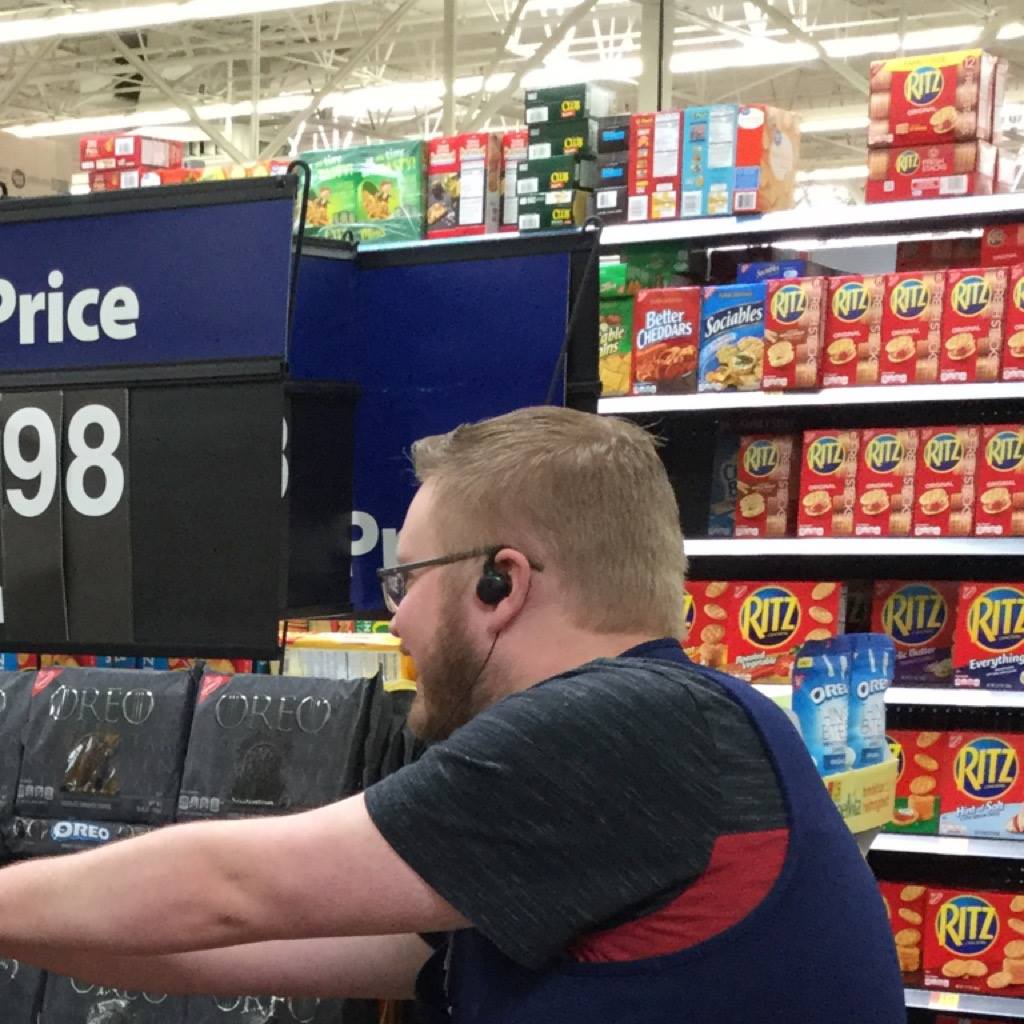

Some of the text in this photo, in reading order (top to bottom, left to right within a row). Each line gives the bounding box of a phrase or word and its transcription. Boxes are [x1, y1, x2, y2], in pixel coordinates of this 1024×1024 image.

[908, 73, 941, 101] RITZ
[772, 290, 805, 319] RITZ
[835, 286, 869, 317] RITZ
[893, 282, 927, 313] RITZ
[953, 282, 991, 310] RITZ
[646, 309, 685, 328] Better
[704, 305, 764, 338] Sociables
[637, 322, 693, 349] CHEDDARS
[745, 445, 776, 472] RITZ
[809, 442, 844, 469] RITZ
[867, 440, 901, 468] RITZ
[926, 438, 962, 467] RITZ
[742, 595, 798, 640] RITZ
[885, 593, 943, 637] RITZ
[970, 597, 1024, 644] RITZ
[969, 653, 1024, 671] Everything
[49, 684, 155, 725] OREO
[215, 693, 332, 734] OREO
[957, 746, 1016, 791] RITZ
[52, 821, 110, 841] OREO
[938, 903, 996, 946] RITZ
